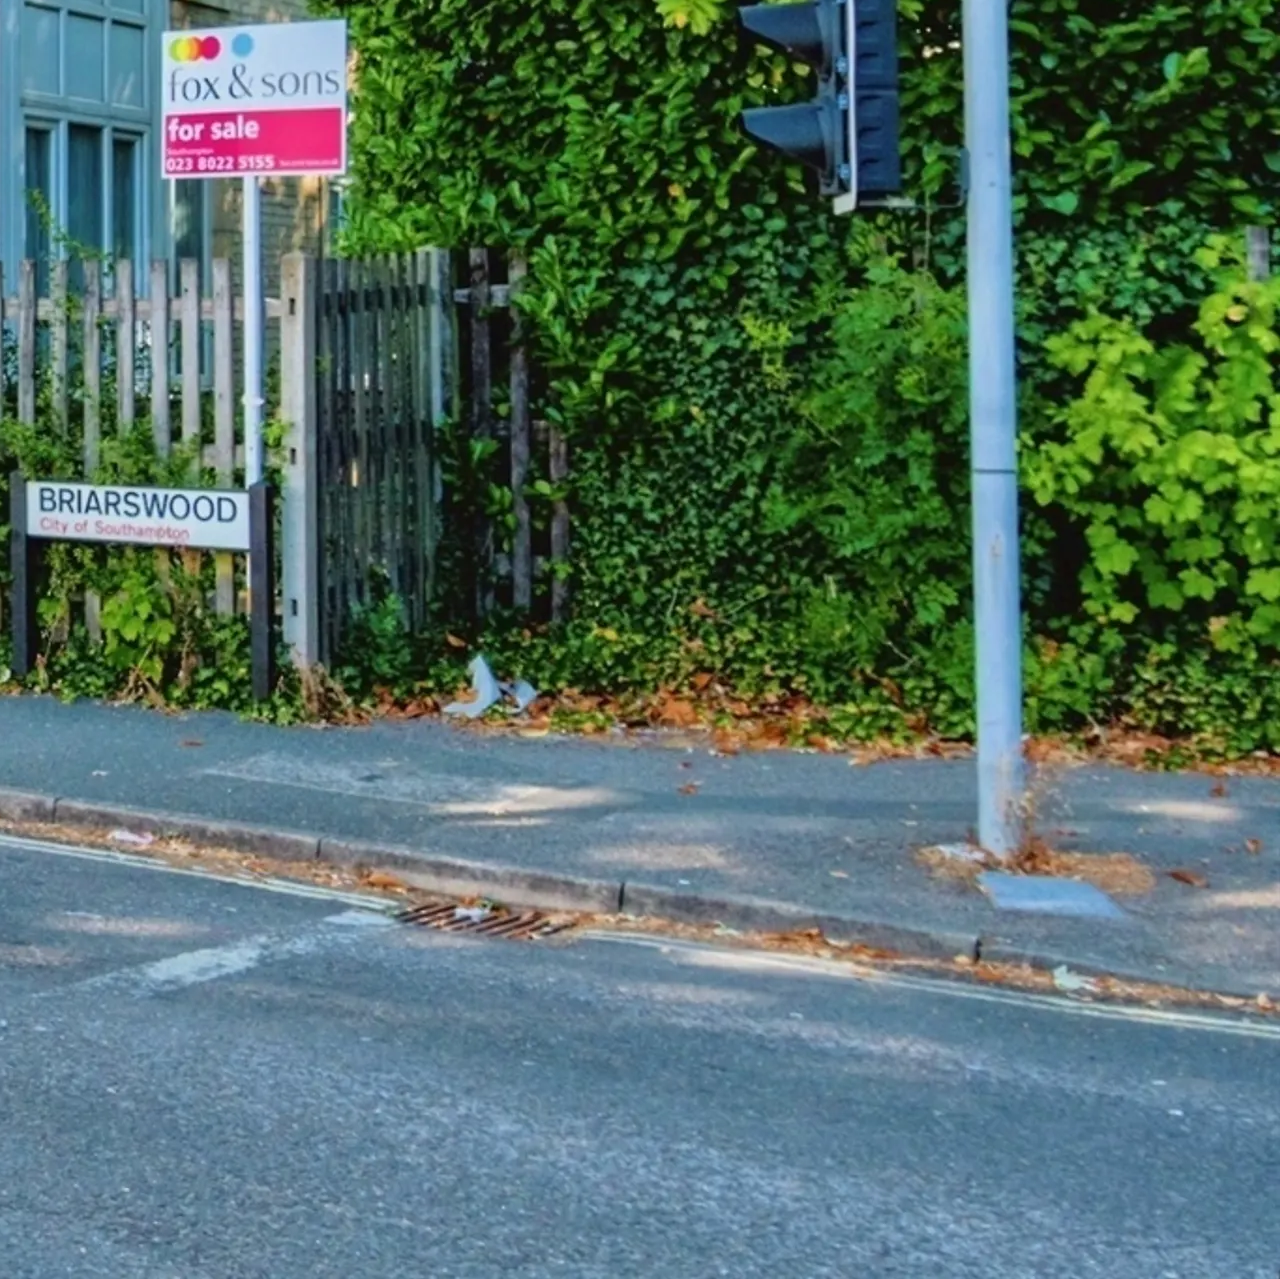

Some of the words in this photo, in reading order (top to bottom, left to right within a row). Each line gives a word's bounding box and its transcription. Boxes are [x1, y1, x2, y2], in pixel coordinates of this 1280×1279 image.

[169, 68, 220, 102] fox
[228, 63, 253, 100] &
[261, 70, 340, 98] sons
[168, 118, 204, 142] for
[211, 115, 260, 140] sale
[166, 157, 193, 171] 023
[197, 155, 234, 170] 8022
[238, 154, 275, 169] 5155
[40, 487, 237, 523] BRIARSWOOD
[40, 517, 67, 534] City
[74, 521, 89, 533] of
[95, 520, 189, 540] Southampton
